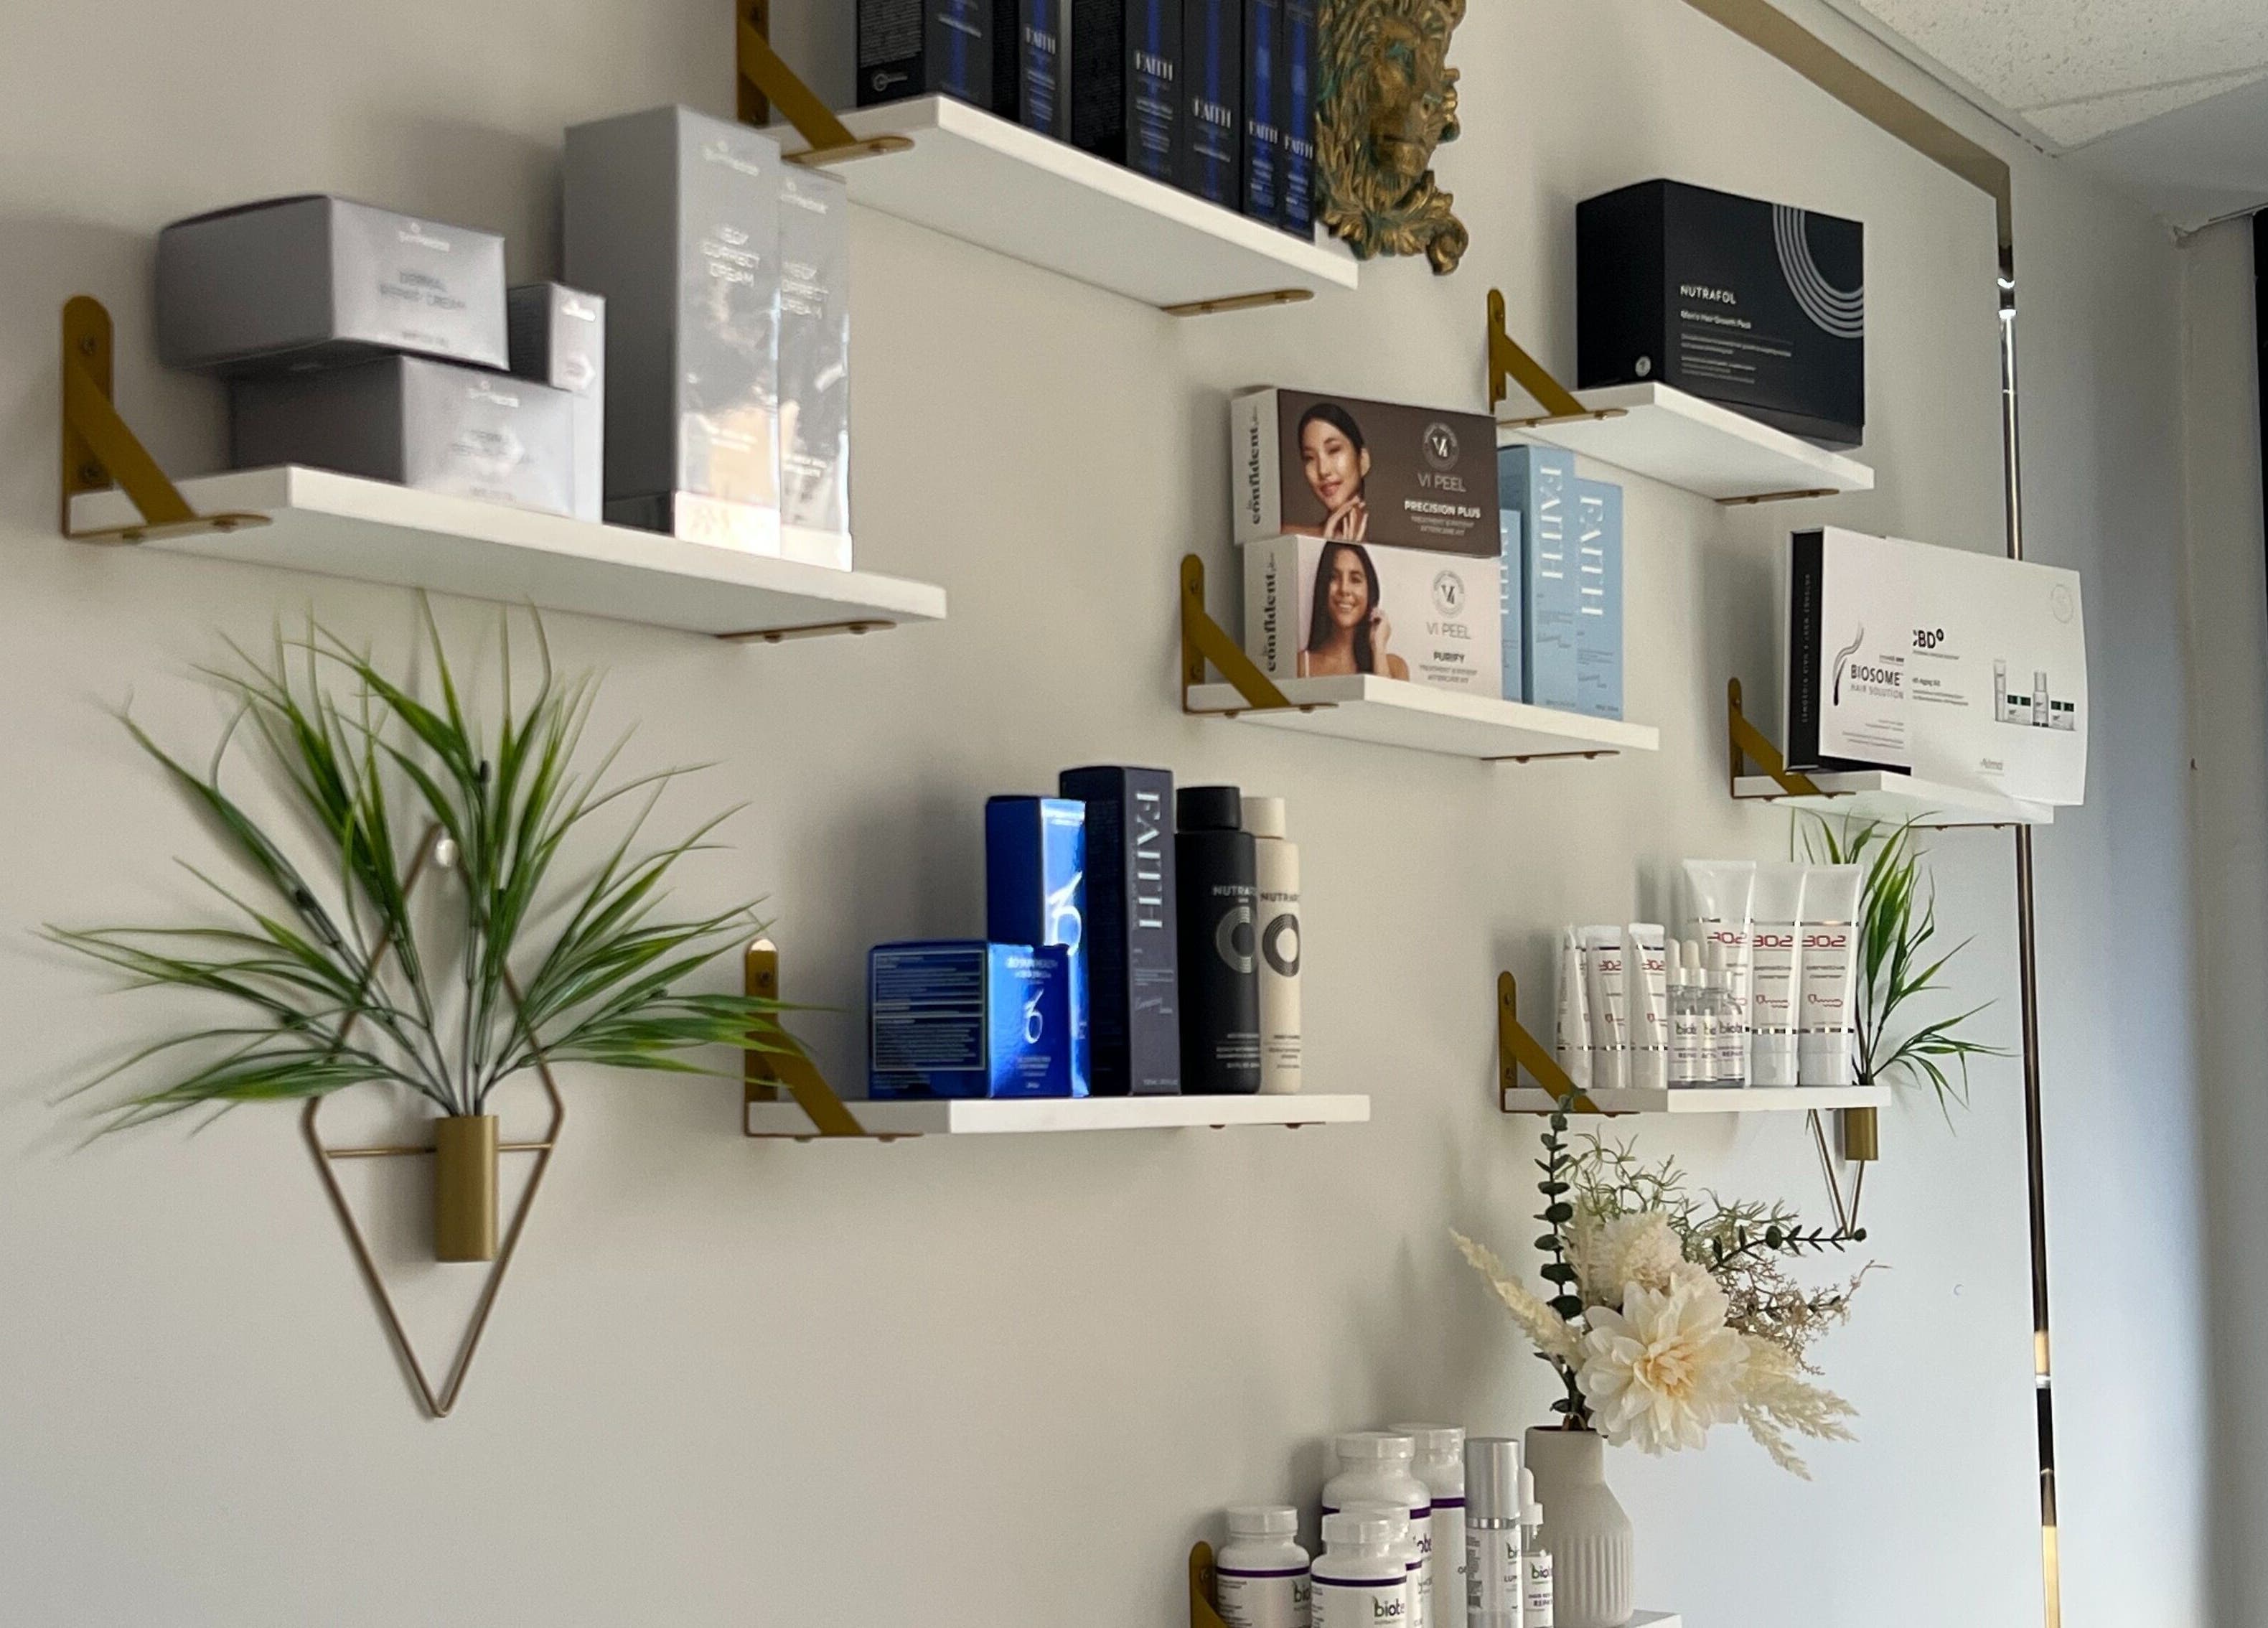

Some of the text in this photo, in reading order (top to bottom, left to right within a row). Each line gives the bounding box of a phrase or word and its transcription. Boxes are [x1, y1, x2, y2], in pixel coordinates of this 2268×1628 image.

[1135, 51, 1173, 83] FAITH
[1194, 98, 1232, 129] FAITH
[1249, 121, 1278, 144] FAITH
[1284, 135, 1313, 160] FAITH
[1680, 285, 1737, 305] NUTRAFOL
[1418, 472, 1467, 492] VI PEEL
[1404, 499, 1481, 519] PRECISION PLUS
[1540, 467, 1563, 580] FAITH
[1580, 496, 1603, 615] FAITH
[1264, 574, 1277, 673] confident
[1425, 621, 1472, 640] VI PEEL
[1433, 650, 1466, 664] PURIFY
[1850, 663, 1901, 686] BIOSOME
[1136, 792, 1163, 928] FAITH
[1752, 935, 1793, 948] 302
[1801, 935, 1846, 948] 302
